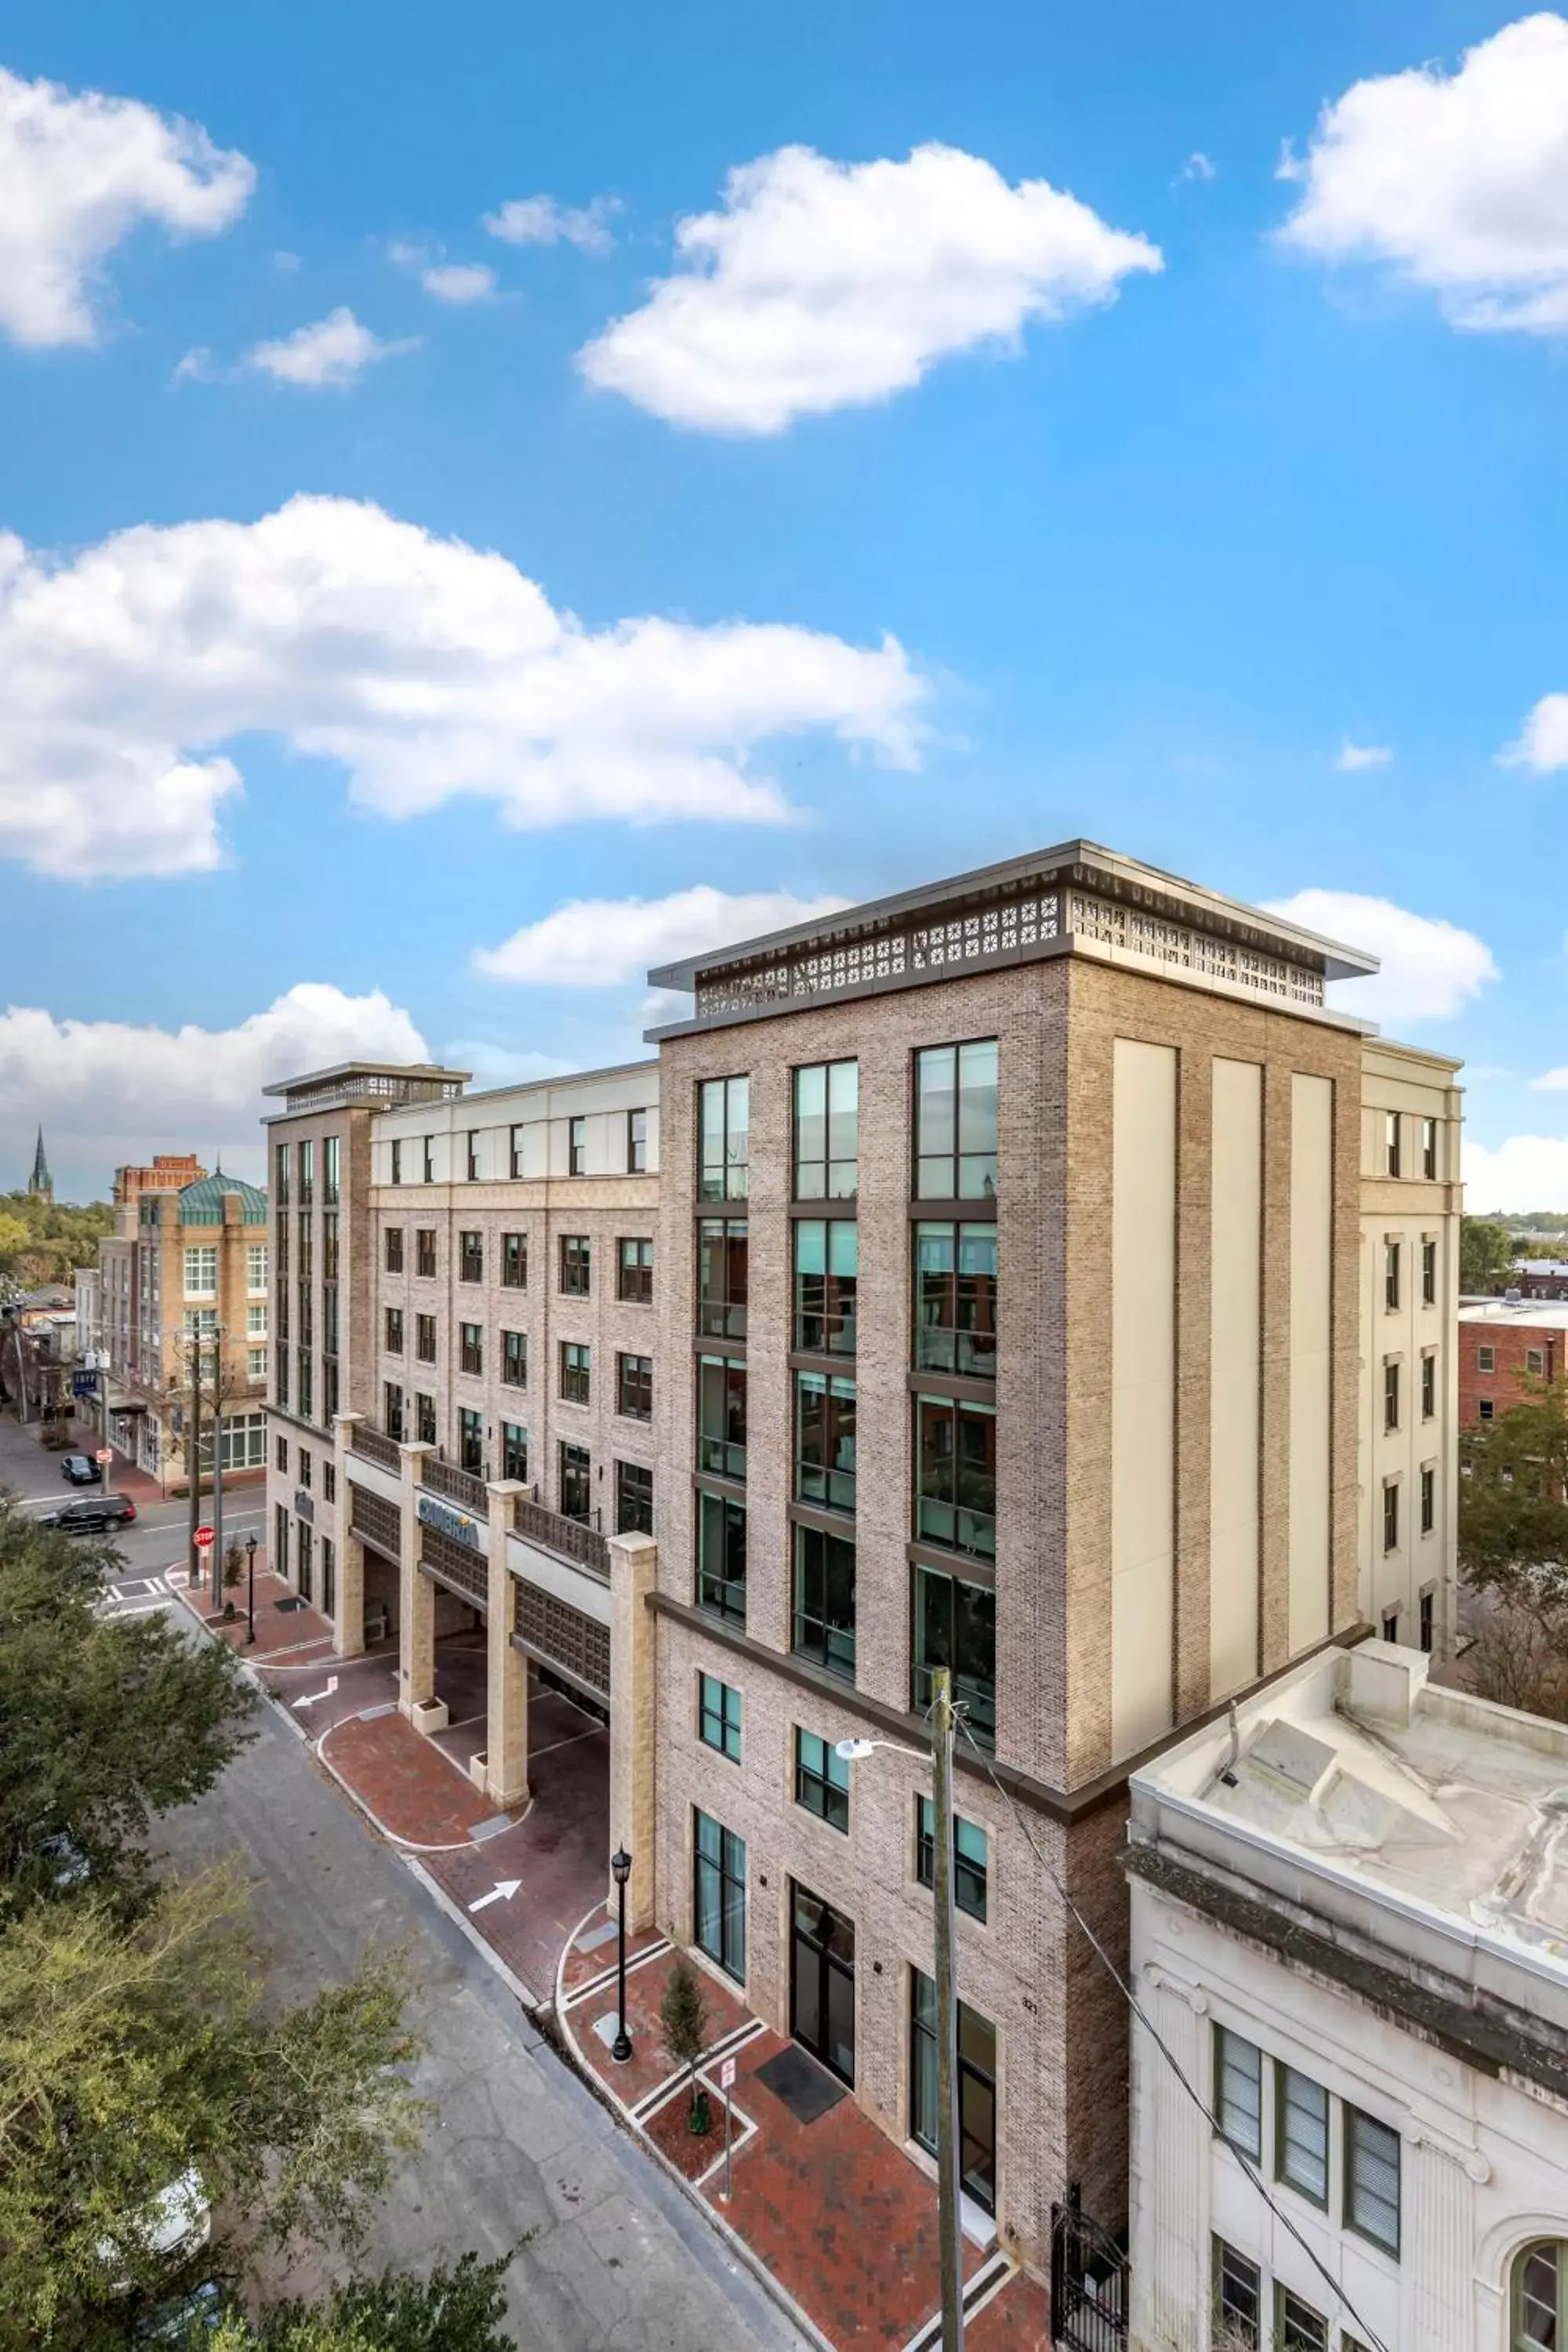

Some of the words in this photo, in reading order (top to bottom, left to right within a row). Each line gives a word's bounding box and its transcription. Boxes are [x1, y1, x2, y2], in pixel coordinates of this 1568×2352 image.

[419, 1497, 479, 1550] CAMBRIA
[194, 1531, 214, 1543] STOP
[1022, 1996, 1037, 2016] 321
